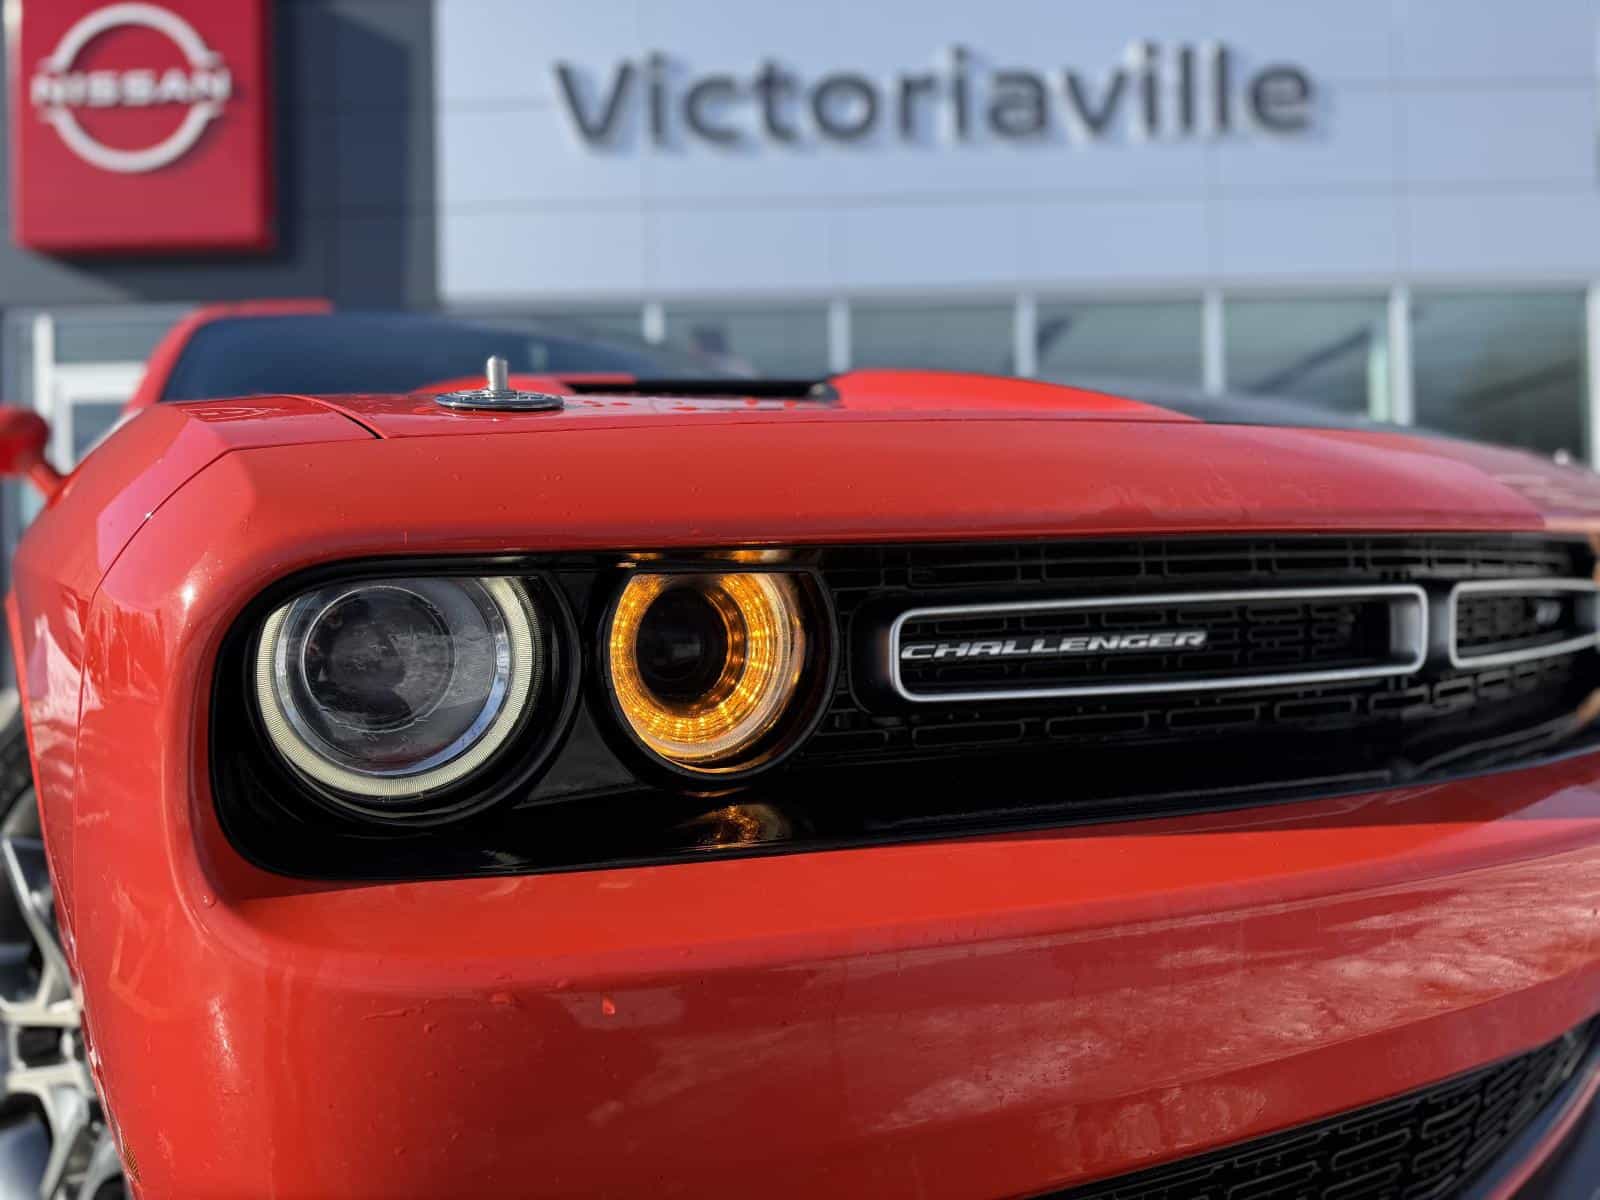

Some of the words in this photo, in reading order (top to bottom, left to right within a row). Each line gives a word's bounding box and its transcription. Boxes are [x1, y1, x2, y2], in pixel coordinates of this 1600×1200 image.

[30, 67, 232, 108] NISSAN
[553, 42, 1315, 151] Victoriaville
[900, 630, 1208, 661] CHALLENGER
